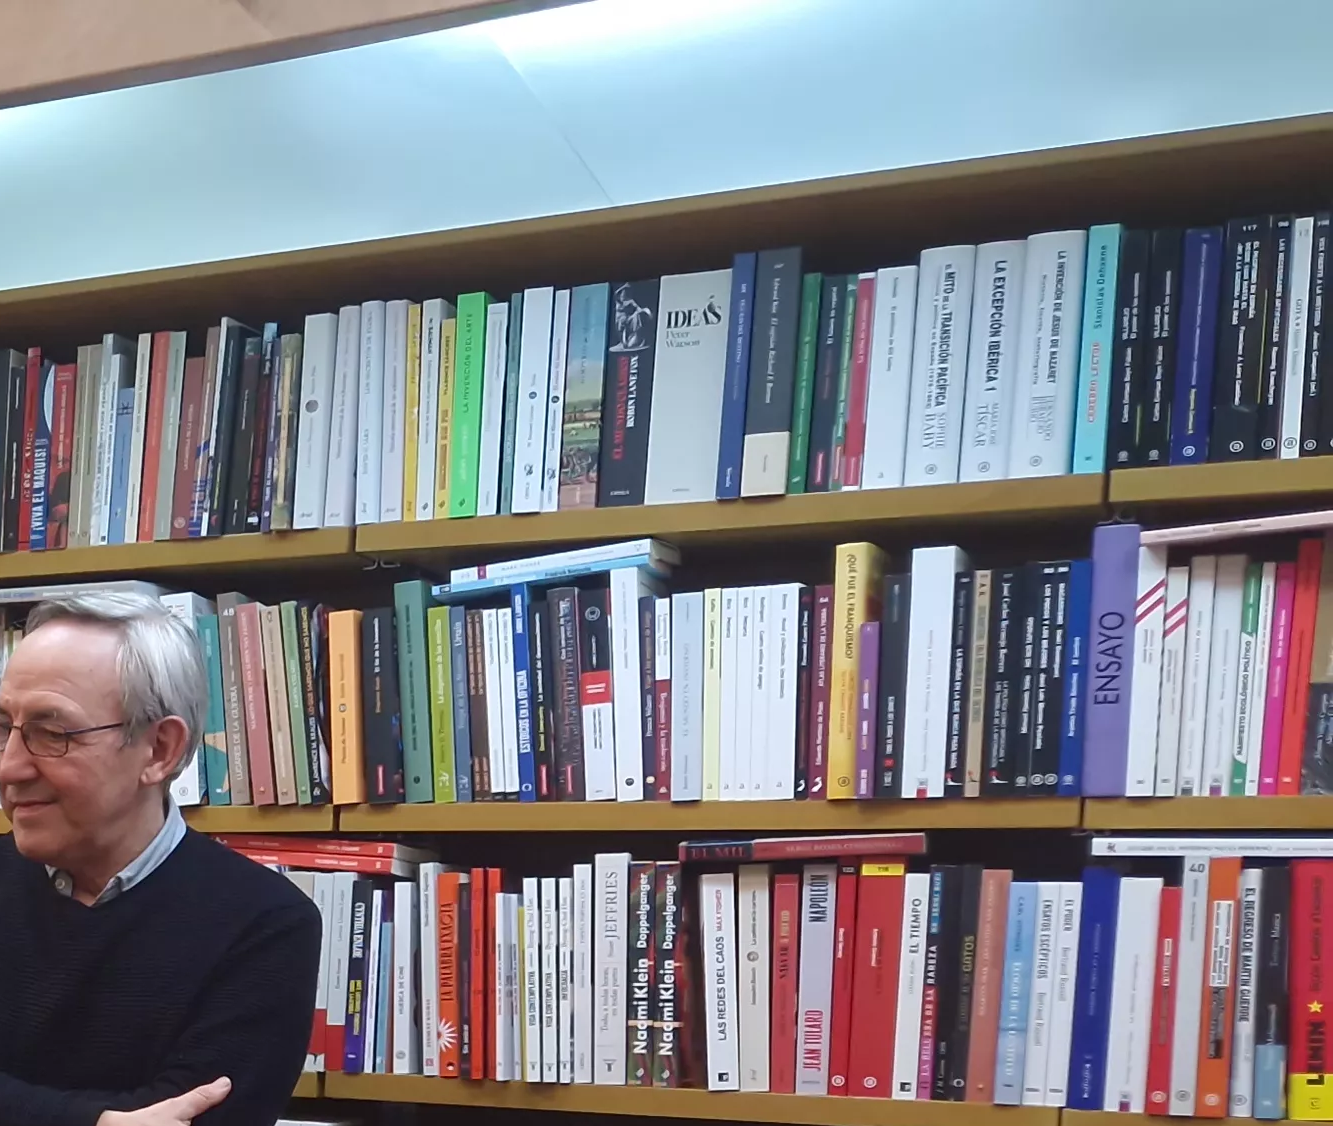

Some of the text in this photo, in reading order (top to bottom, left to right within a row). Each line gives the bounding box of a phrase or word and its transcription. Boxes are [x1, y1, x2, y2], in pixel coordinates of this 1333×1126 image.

[986, 260, 1008, 382] LA EXCEPCIÓN IBÉRICA
[1047, 261, 1066, 383] INVENCIÓN DE DE NAZARET
[1093, 245, 1108, 329] Stanislas Dehaene
[463, 355, 472, 399] INVENCIÓN
[666, 339, 700, 348] Watson
[934, 271, 956, 406] MITO TRANSICIÓN PACÍFICA
[974, 404, 993, 447] TÍSCAR
[30, 449, 47, 530] ¡VIVA EL MAQUIS!
[844, 575, 857, 659] FUE FRANQUISMO?
[1093, 611, 1125, 706] ENSAYO
[1236, 640, 1252, 756] MANIFIESTO ECOLÓGICO POLÍTICO
[605, 871, 620, 940] JEFFRIES
[803, 874, 829, 922] NAPOLEÓN
[1189, 863, 1205, 873] 40
[636, 873, 650, 949] Doppelganger
[662, 874, 676, 950] Doppelganger
[909, 899, 922, 954] EL TIEMPO
[1037, 899, 1052, 979] ENSAYOS ESCÉPTICOS
[440, 946, 454, 988] PALABRA
[716, 936, 727, 1041] LAS REDES DEL CAOS
[1237, 887, 1256, 1023] EL REGRESO DE GUERRE
[633, 958, 649, 1054] Naomi Klein
[659, 959, 675, 1056] Naomi Klein
[802, 1009, 823, 1072] JEAN TULARD
